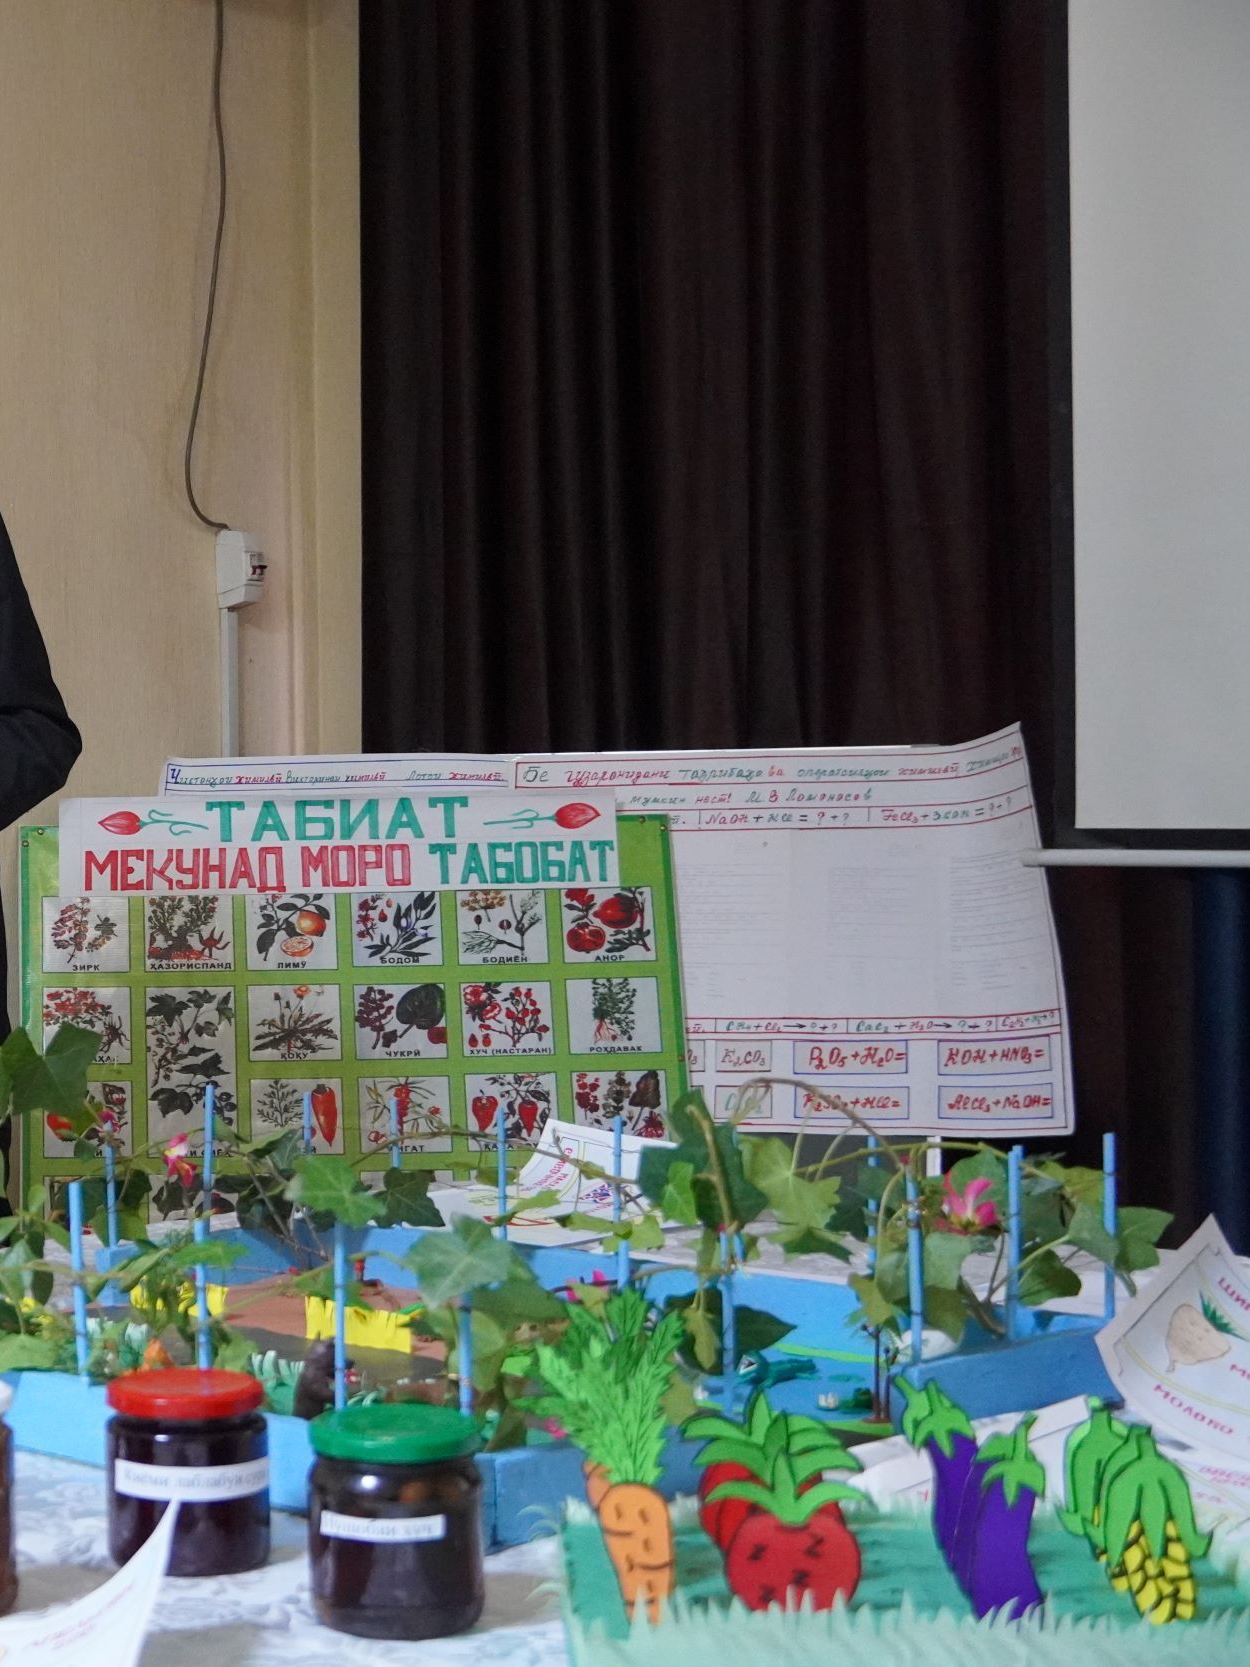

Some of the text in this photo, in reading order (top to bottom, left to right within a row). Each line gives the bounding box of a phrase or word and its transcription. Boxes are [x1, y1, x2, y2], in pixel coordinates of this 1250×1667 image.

[205, 796, 469, 843] ТАБИАТ
[84, 839, 615, 894] МЕКУНАД МОРО ТАБОБАТ
[380, 956, 420, 965] БОДОМ
[482, 956, 528, 964] БОДИЁН
[594, 954, 626, 962] АНОР
[72, 964, 100, 972] ЗИРК
[492, 1047, 551, 1055] (НАСТАРАН)
